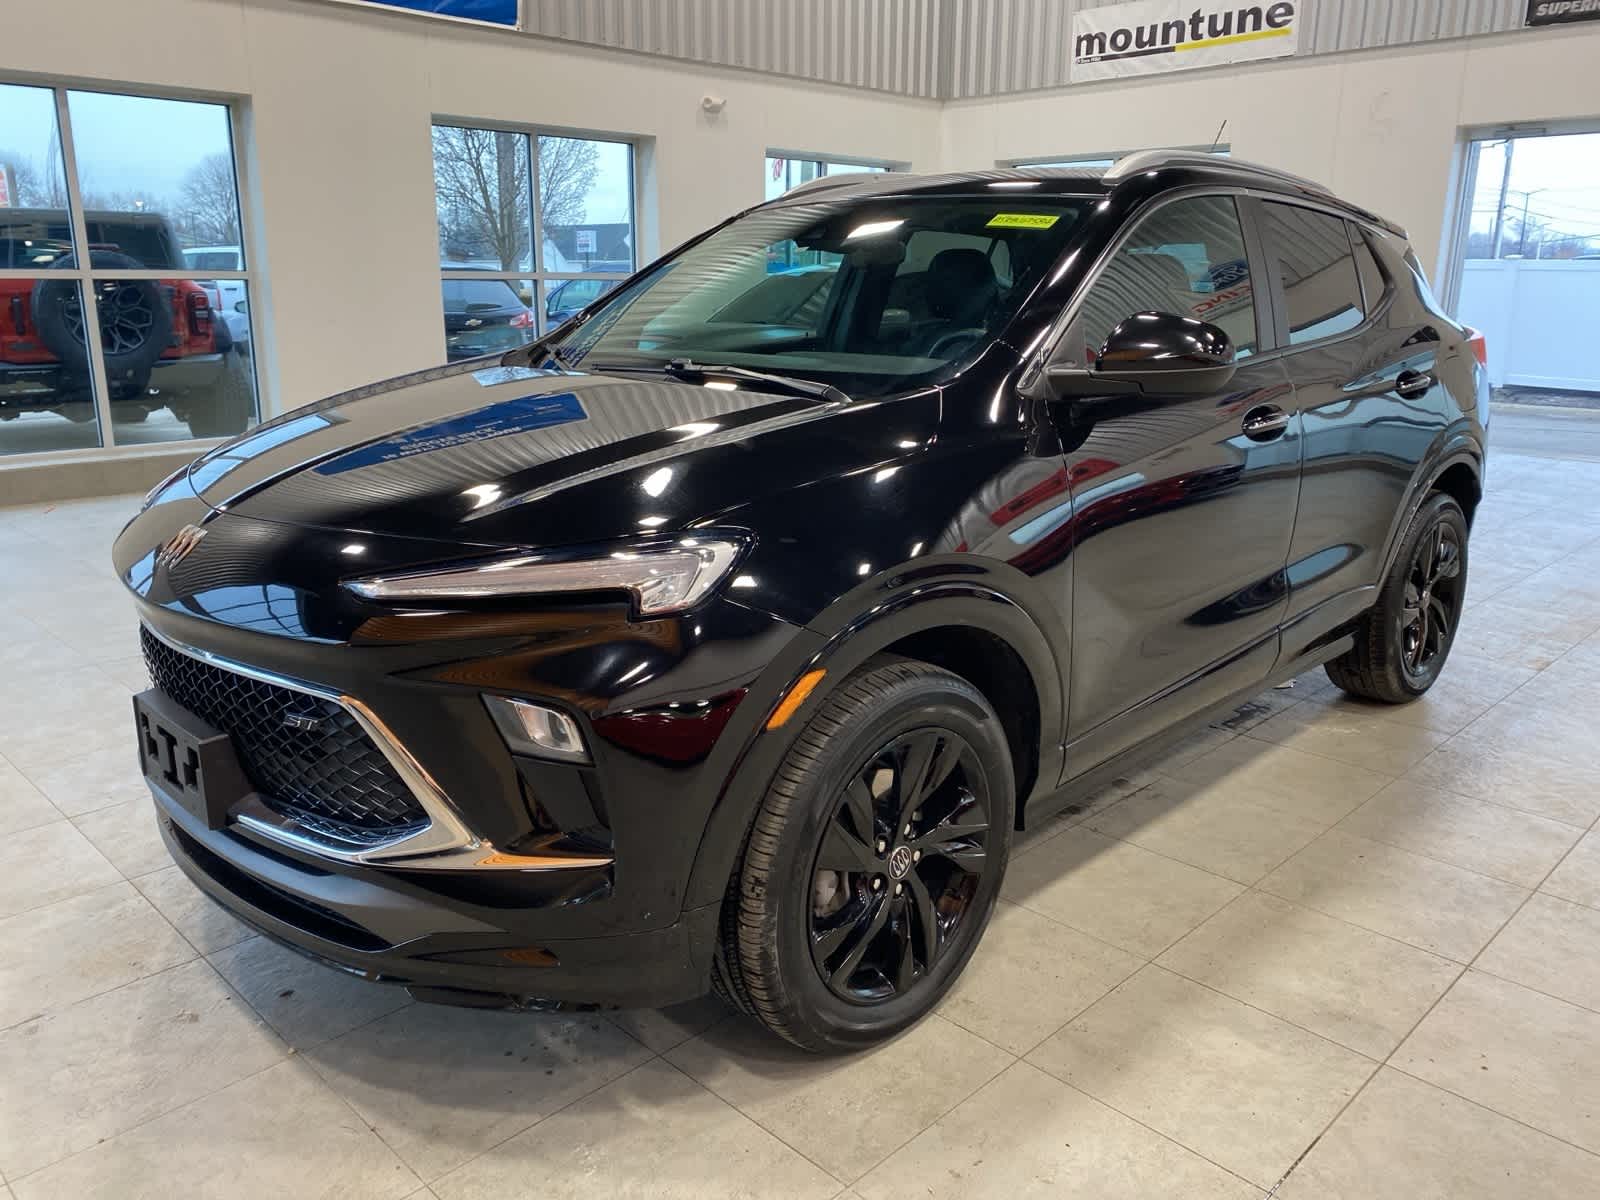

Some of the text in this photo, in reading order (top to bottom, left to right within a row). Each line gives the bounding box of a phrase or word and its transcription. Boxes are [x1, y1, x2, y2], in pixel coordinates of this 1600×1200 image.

[1536, 0, 1600, 16] SUPER
[1075, 1, 1294, 57] mountune
[283, 712, 318, 731] ST
